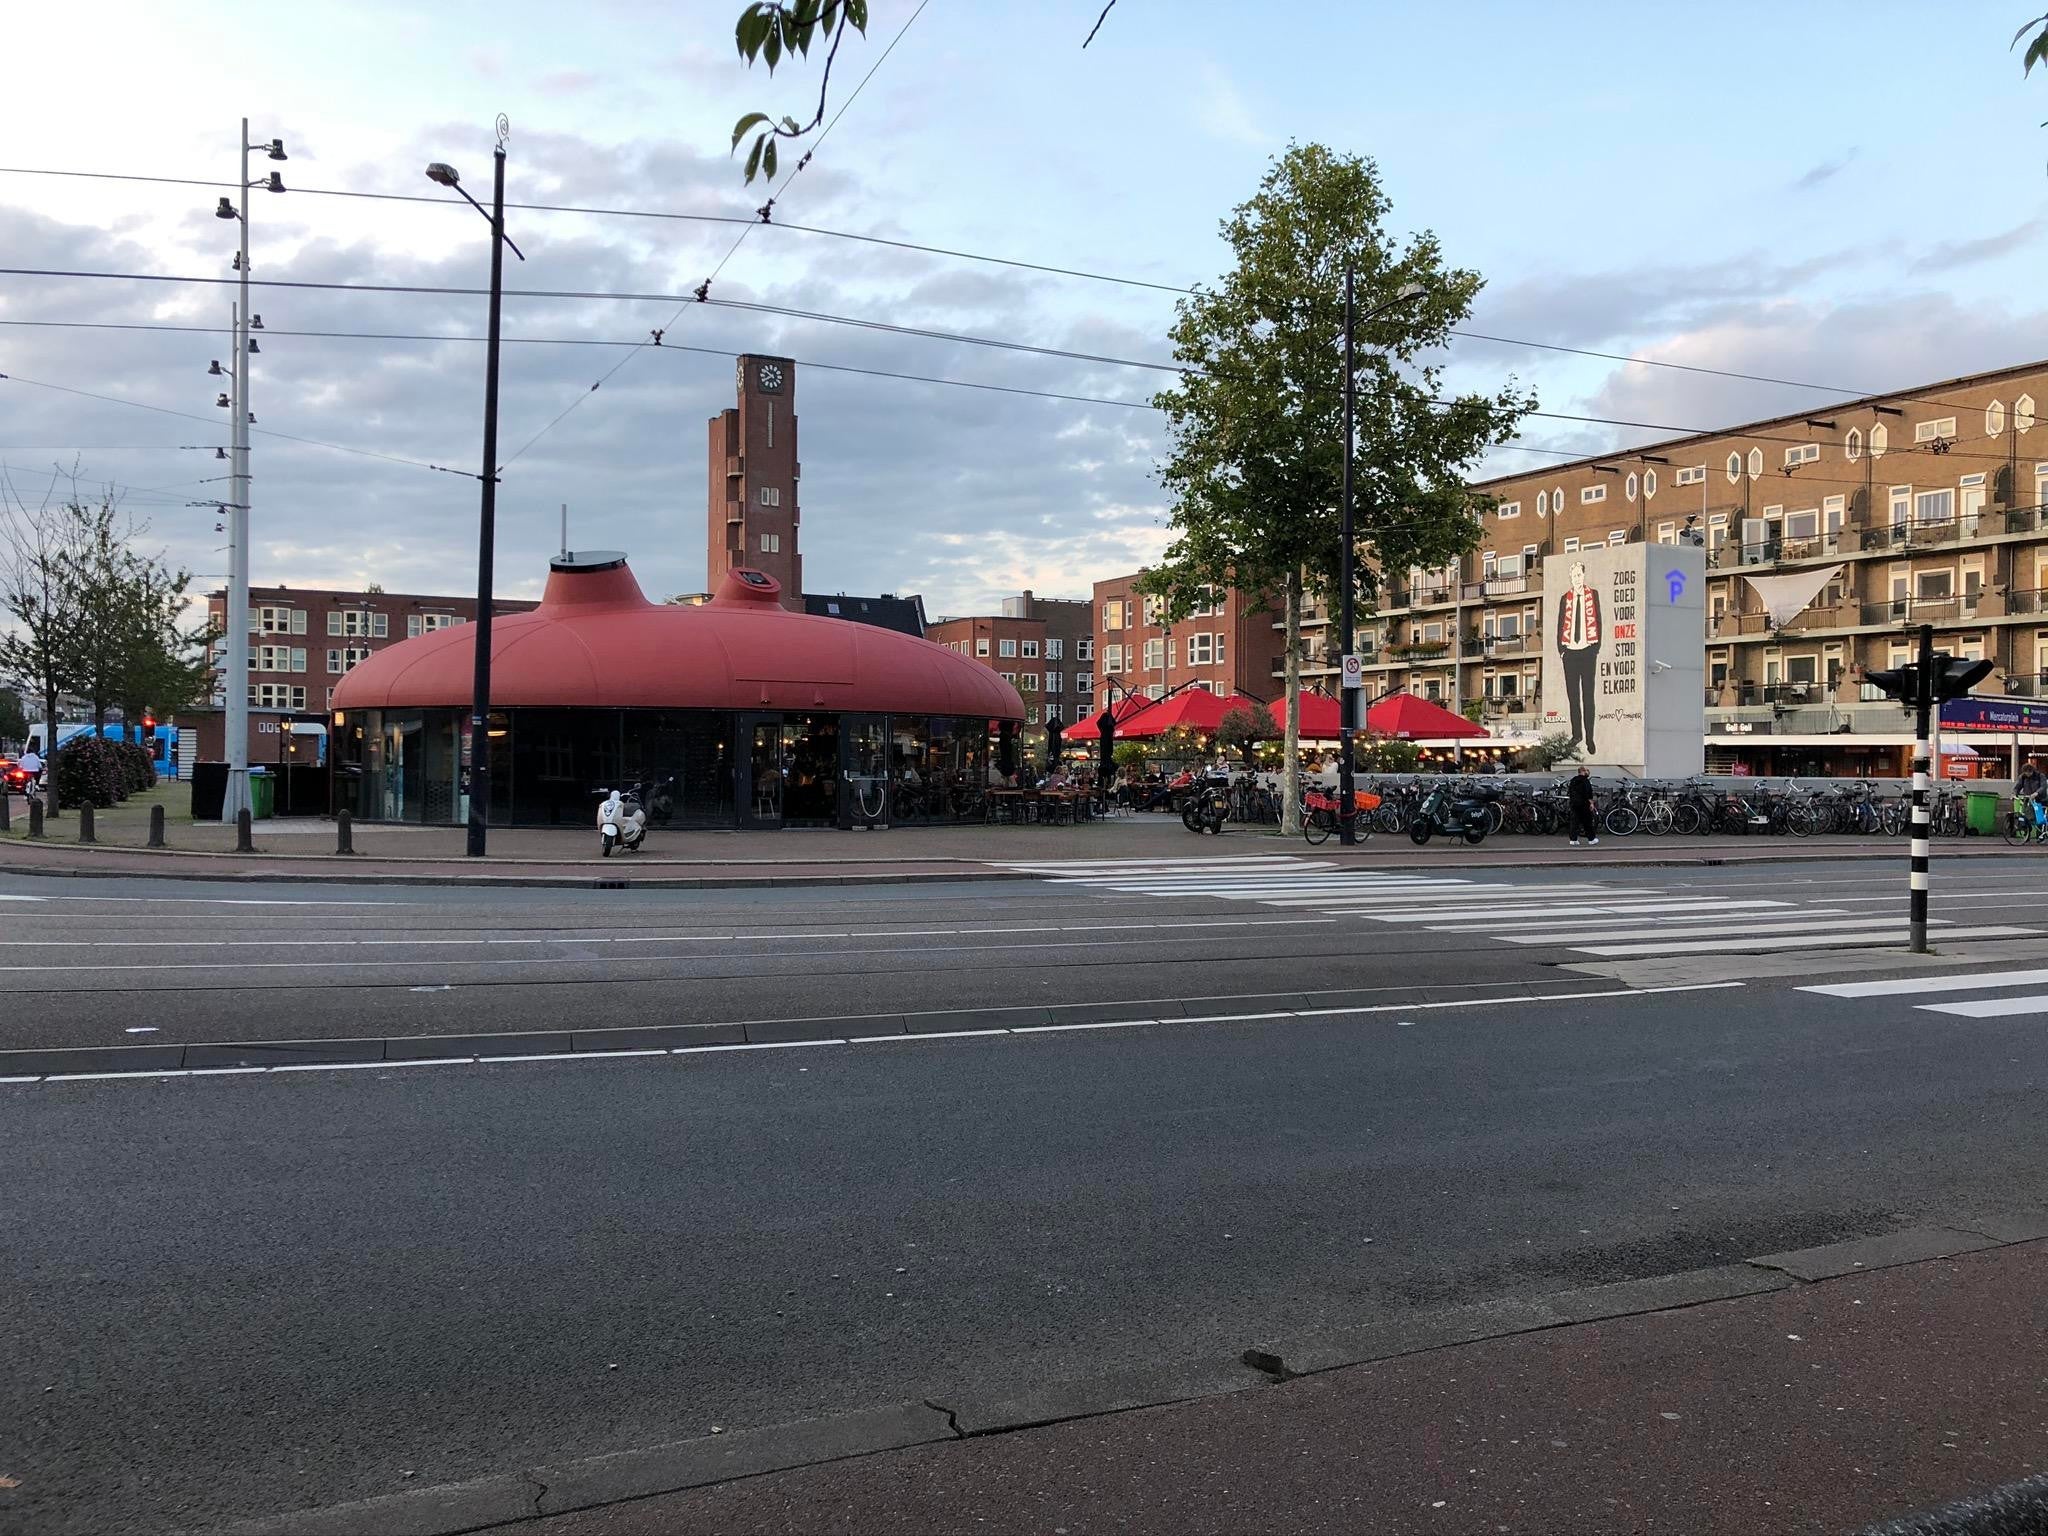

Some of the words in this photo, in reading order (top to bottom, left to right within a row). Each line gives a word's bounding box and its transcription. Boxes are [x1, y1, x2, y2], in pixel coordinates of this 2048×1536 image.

[1614, 571, 1636, 585] ZORG
[1614, 588, 1636, 602] GOED
[1671, 581, 1683, 603] P
[1563, 600, 1572, 640] AJAX
[1614, 606, 1636, 621] VOOR
[1614, 623, 1636, 639] ONZE
[1615, 642, 1636, 657] STAD
[1600, 662, 1611, 677] EN
[1614, 661, 1636, 676] VOOR
[1603, 679, 1636, 695] ELKAAR
